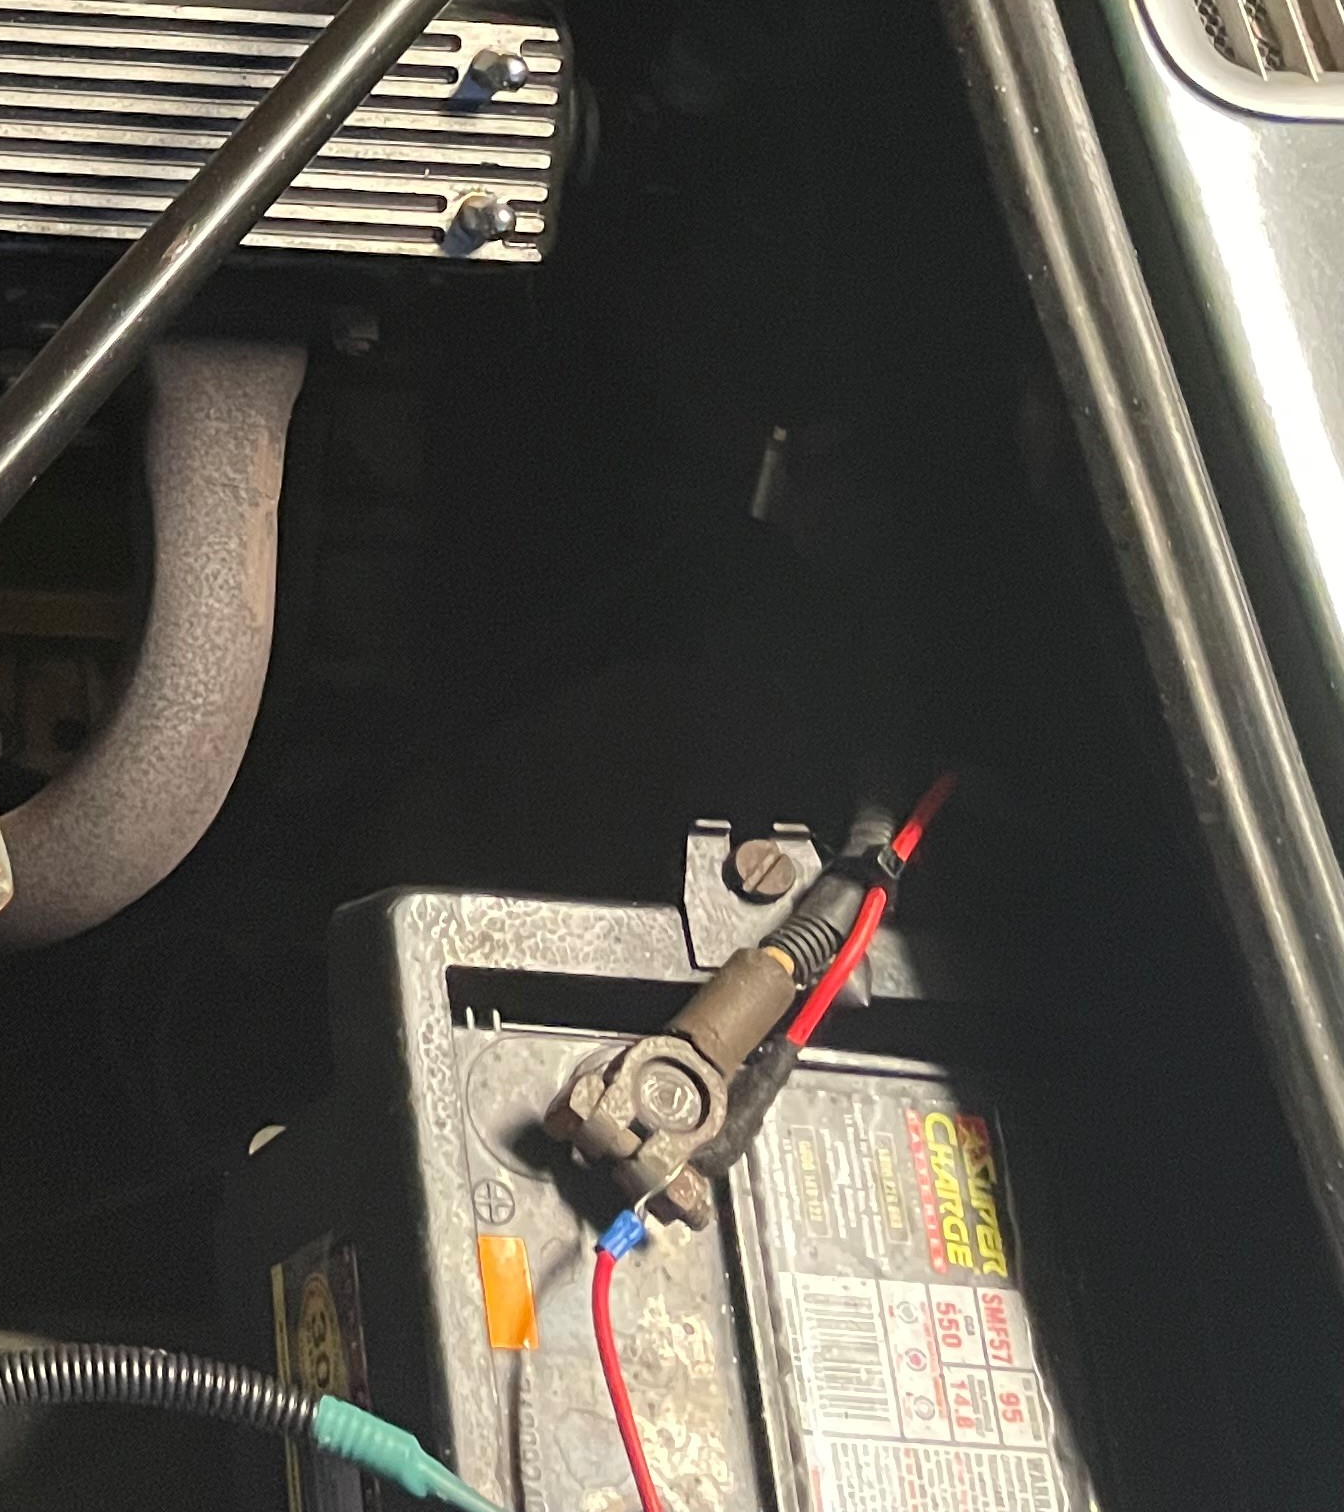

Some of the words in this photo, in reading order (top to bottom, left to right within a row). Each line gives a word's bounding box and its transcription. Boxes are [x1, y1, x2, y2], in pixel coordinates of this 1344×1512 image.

[924, 1111, 974, 1268] CHARGE
[962, 1151, 1009, 1278] SUPER
[935, 1301, 963, 1349] 550
[981, 1292, 1014, 1366] SMF57
[998, 1391, 1025, 1424] 95
